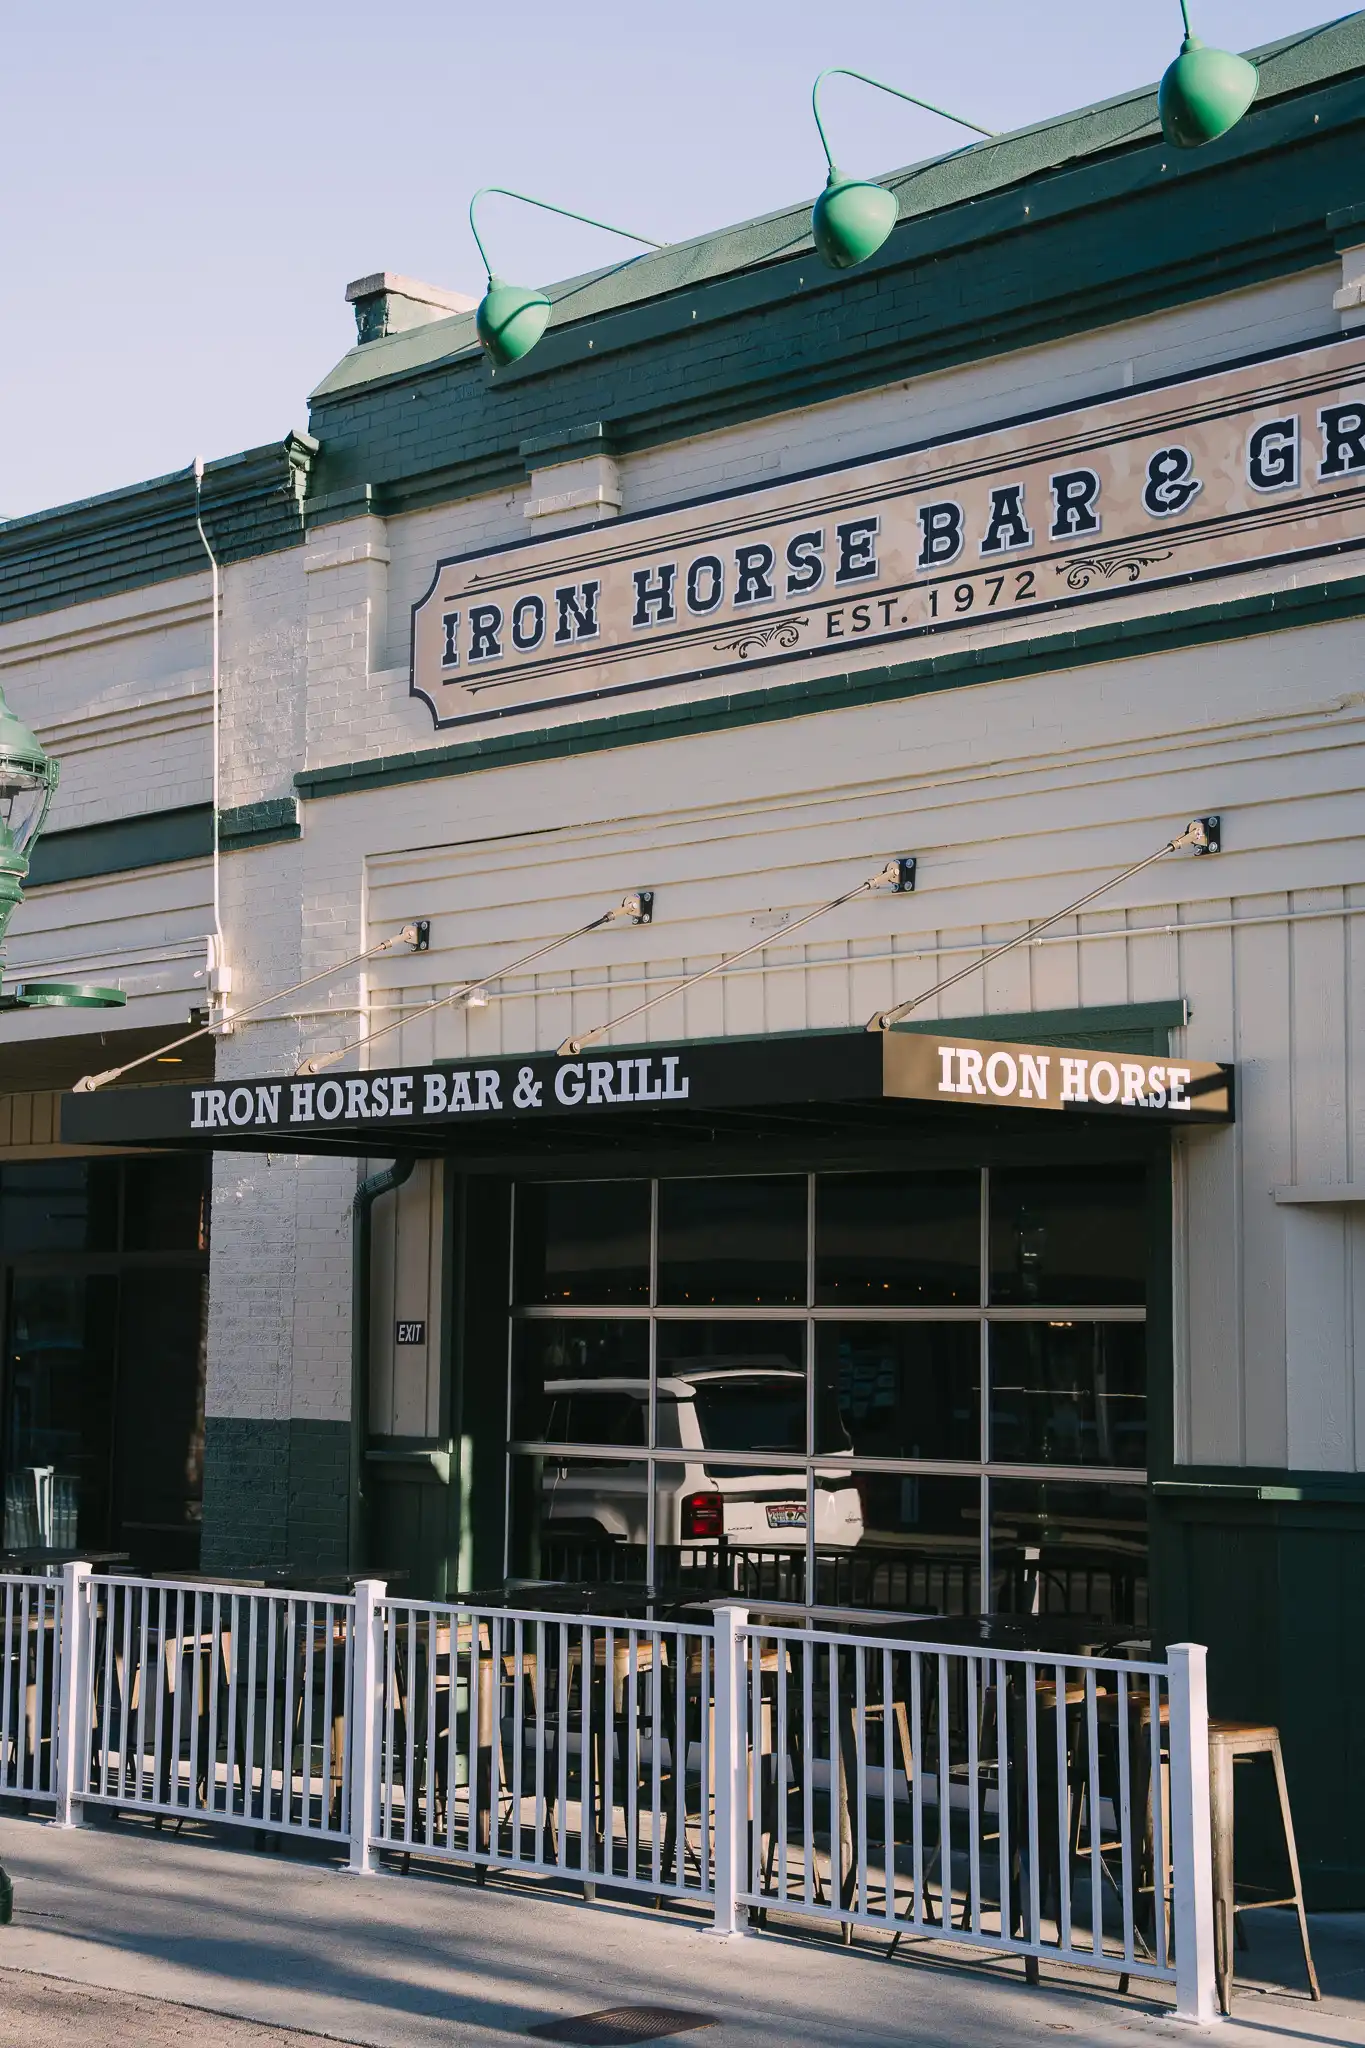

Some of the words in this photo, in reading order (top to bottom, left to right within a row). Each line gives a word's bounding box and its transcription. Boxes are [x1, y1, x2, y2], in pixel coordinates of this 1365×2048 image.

[441, 580, 601, 668] IRON
[631, 514, 881, 628] HORSE
[916, 466, 1102, 570] BAR
[1141, 443, 1203, 517] &
[1245, 400, 1365, 492] GR
[826, 597, 908, 639] EST.
[928, 570, 1037, 618] 1972
[190, 1085, 282, 1128] IRON
[290, 1075, 414, 1122] HORSE
[423, 1069, 503, 1114] BAR
[512, 1066, 545, 1109] &
[555, 1056, 690, 1106] GRILL
[938, 1046, 1050, 1100] IRON
[1060, 1057, 1191, 1111] HORSE
[398, 1324, 422, 1342] EXIT
